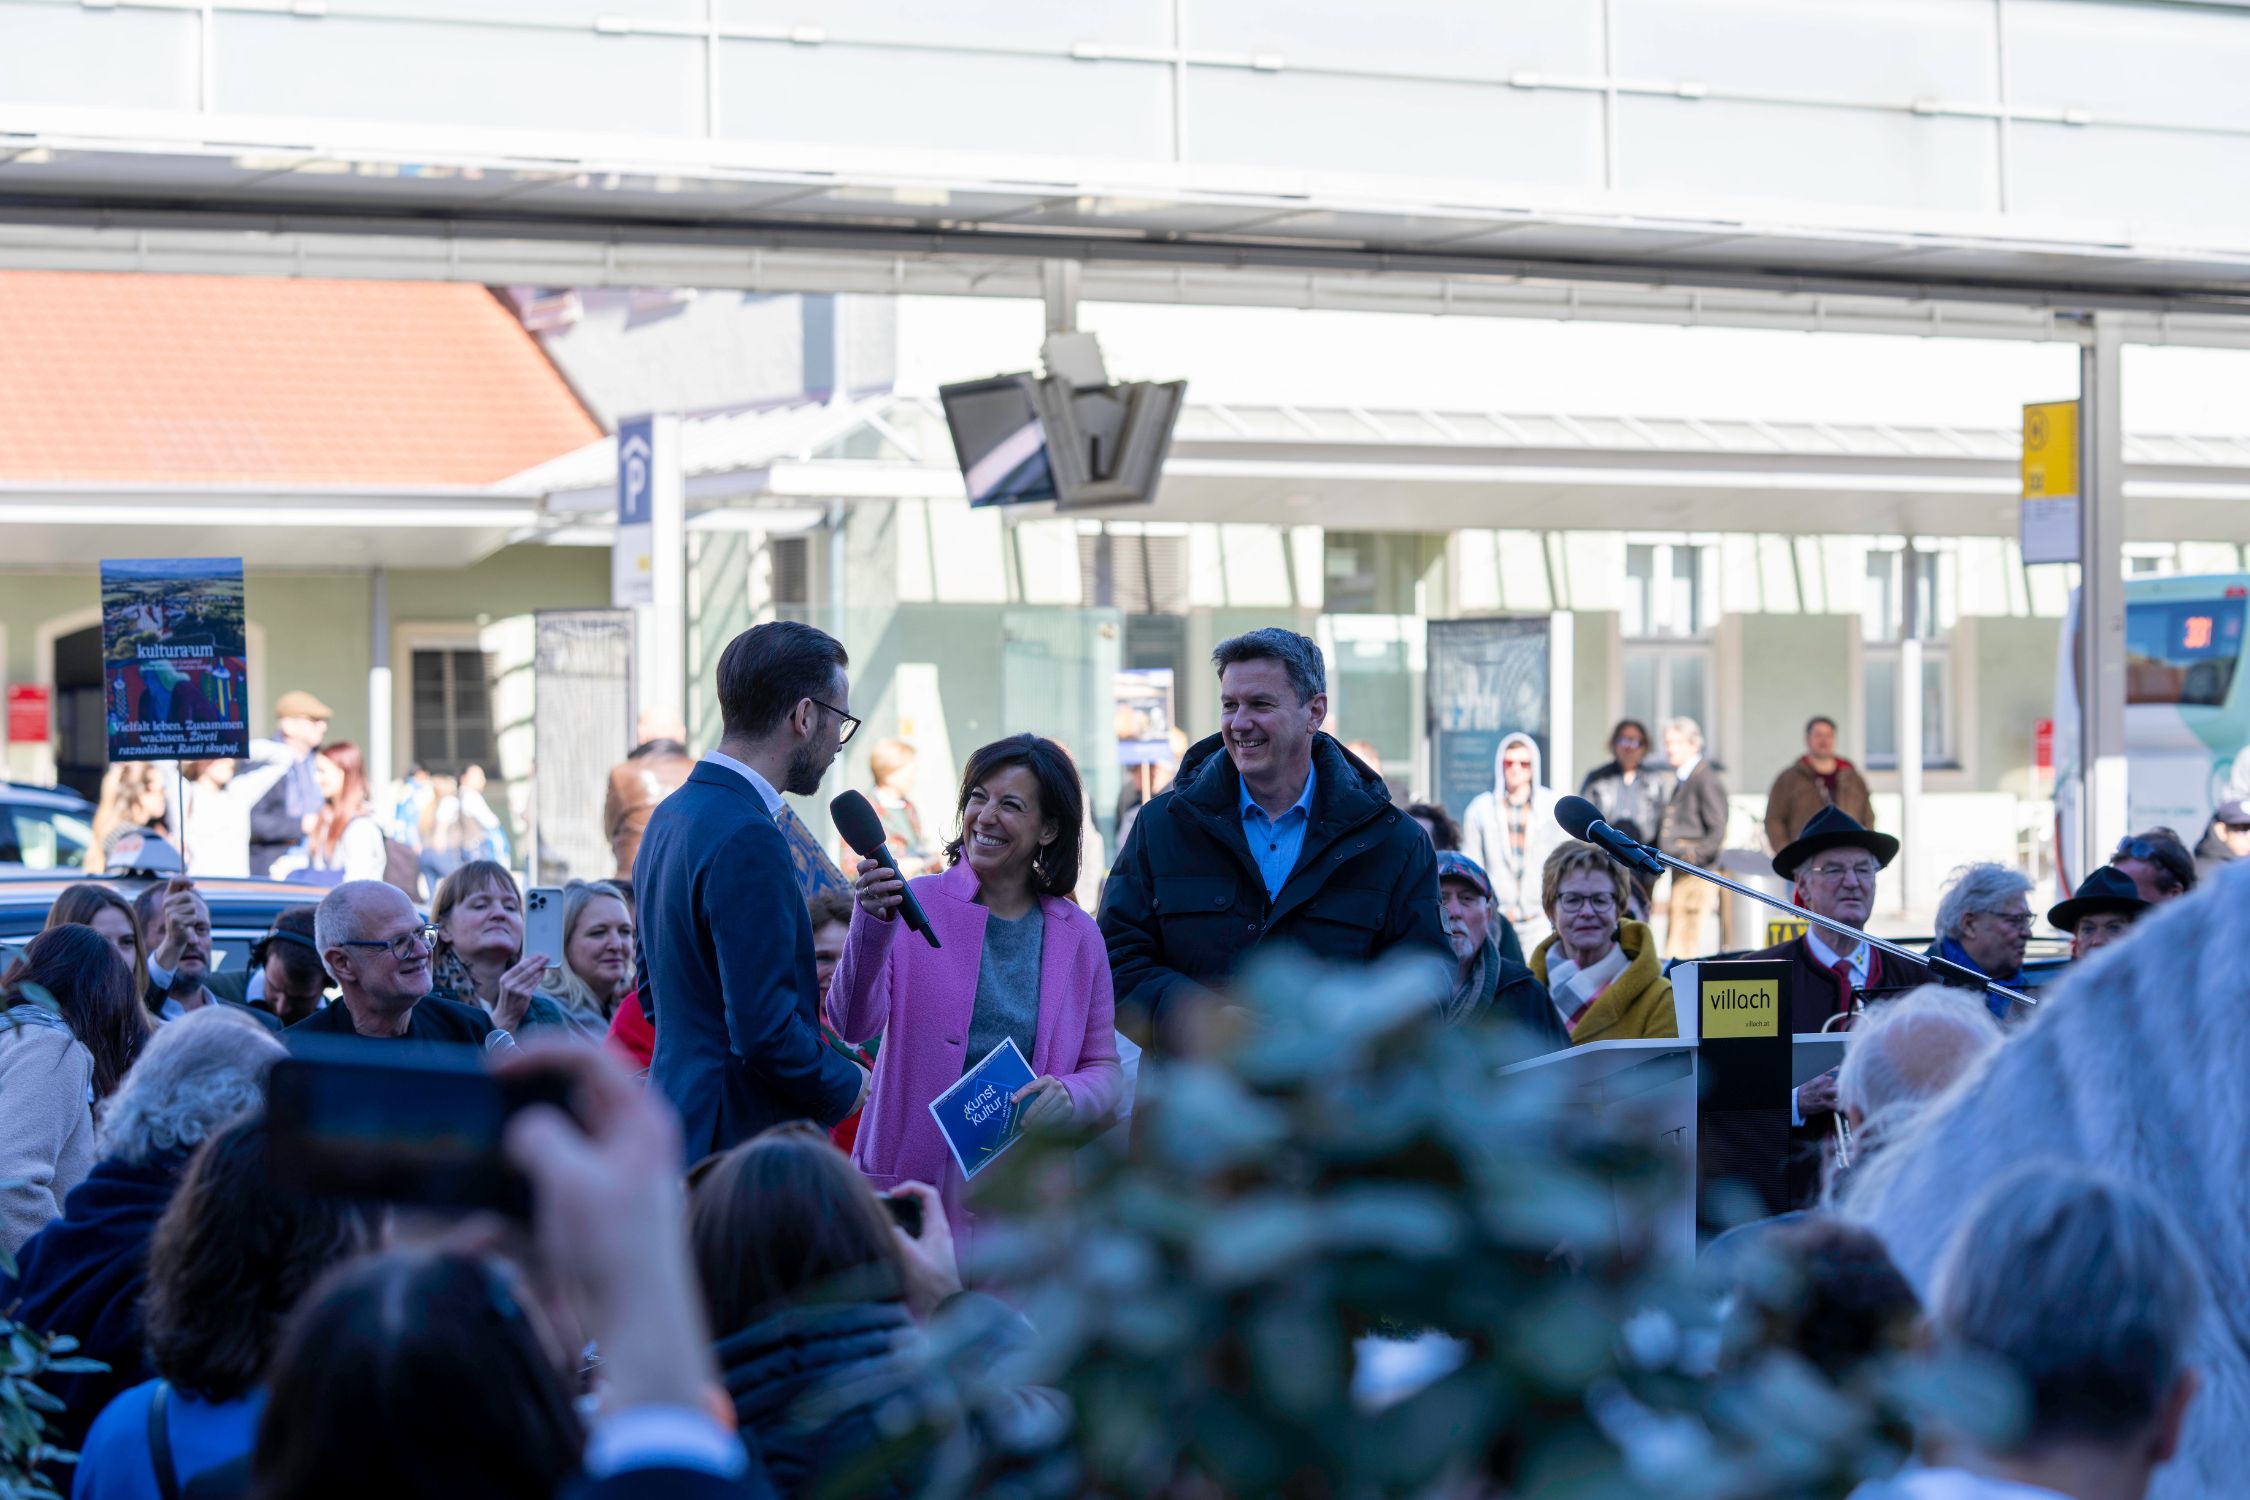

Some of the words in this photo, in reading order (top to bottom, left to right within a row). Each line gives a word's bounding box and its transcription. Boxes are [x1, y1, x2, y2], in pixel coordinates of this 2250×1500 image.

[114, 721, 150, 732] Vielfalt
[152, 720, 183, 731] leben.
[186, 720, 244, 730] Zusammen
[140, 733, 187, 743] wachsen.
[1711, 988, 1770, 1010] villach
[965, 1084, 997, 1115] Kunst
[971, 1097, 1002, 1126] Kultur
